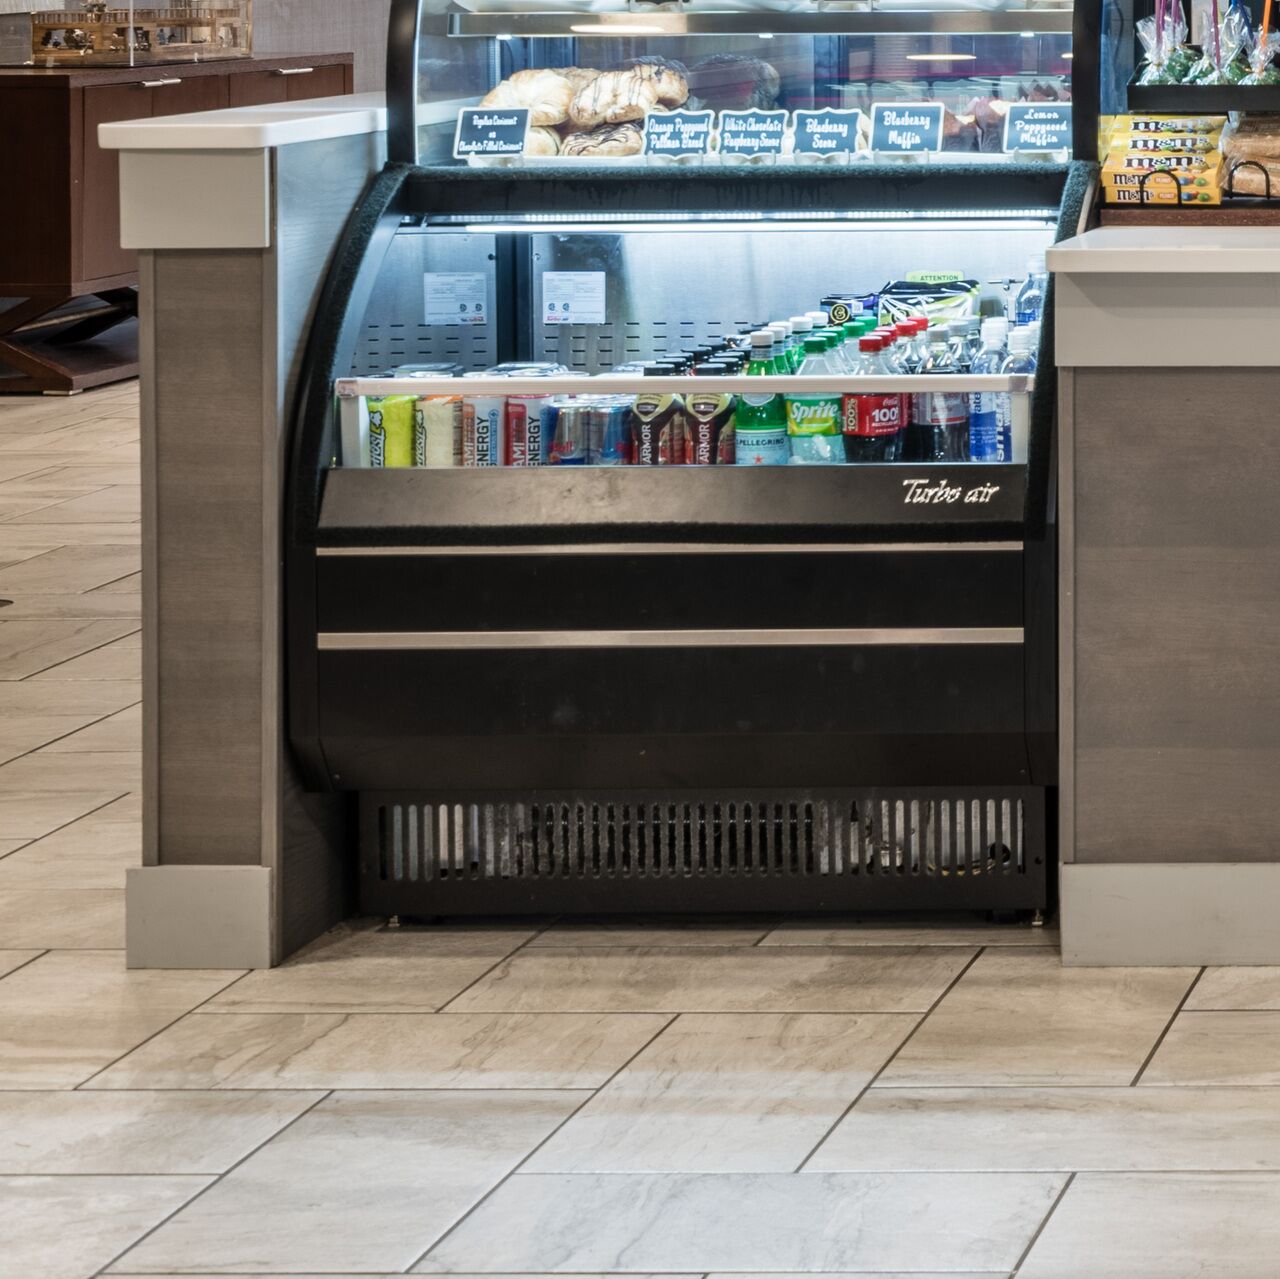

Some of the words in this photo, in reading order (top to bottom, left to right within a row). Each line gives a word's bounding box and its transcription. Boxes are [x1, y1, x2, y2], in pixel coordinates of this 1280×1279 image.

[883, 111, 930, 129] Blueberry
[1024, 109, 1059, 120] Lemon
[724, 119, 746, 131] White
[746, 118, 781, 131] Chocolate
[805, 119, 848, 137] Blueberry
[888, 131, 921, 149] Muffin
[1020, 133, 1058, 146] Muffin
[791, 401, 838, 421] Sprite
[902, 478, 960, 504] Turbo
[963, 482, 999, 503] air
